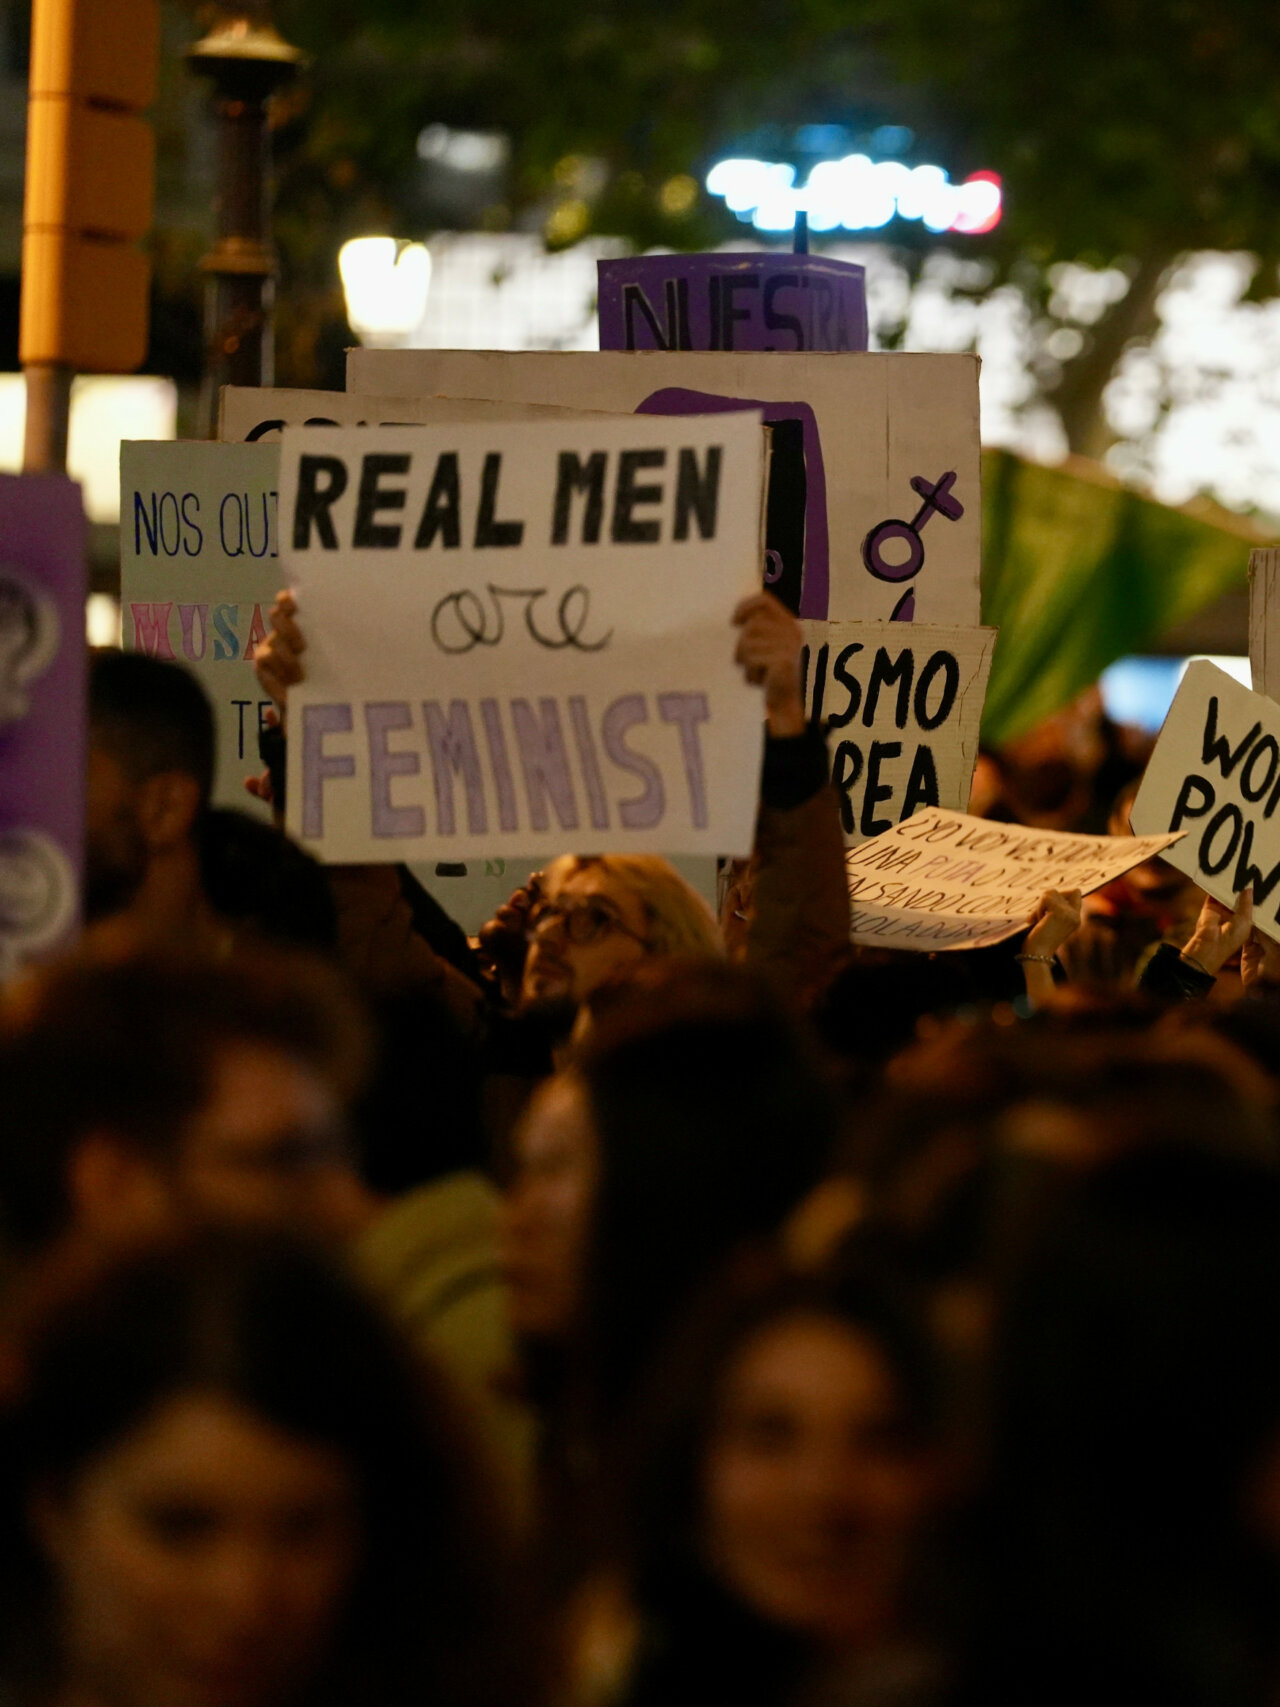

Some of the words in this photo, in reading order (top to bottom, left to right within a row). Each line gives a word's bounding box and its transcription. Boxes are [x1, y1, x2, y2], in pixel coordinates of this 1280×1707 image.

[134, 491, 203, 557] NOS
[292, 450, 525, 551] REAL
[551, 445, 724, 546] MEN
[431, 584, 614, 654] are
[302, 692, 713, 840] FEMINIST
[832, 740, 940, 837] REA
[846, 839, 923, 875] UNA
[908, 854, 988, 883] PUTA
